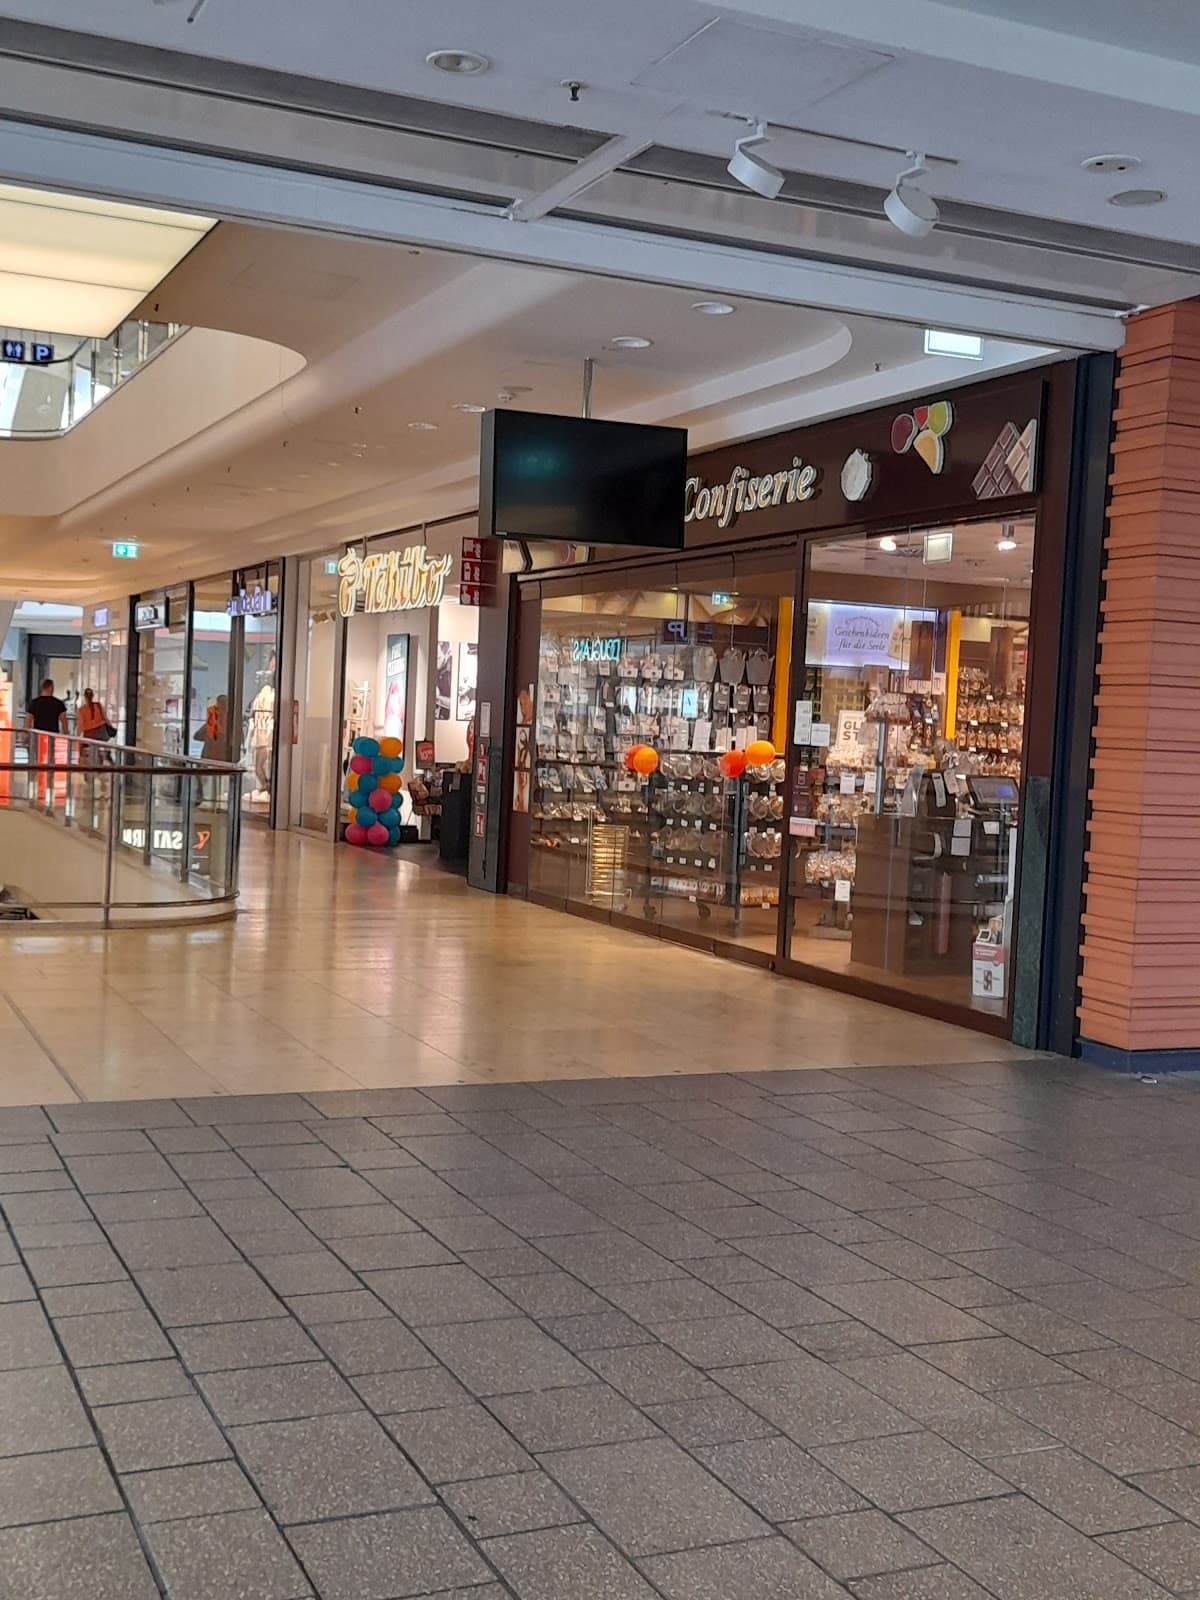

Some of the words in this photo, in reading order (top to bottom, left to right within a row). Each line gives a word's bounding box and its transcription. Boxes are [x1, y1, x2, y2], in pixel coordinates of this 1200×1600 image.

[36, 344, 50, 360] P
[684, 456, 817, 528] Confiserie
[361, 546, 453, 613] Tchibo
[834, 625, 890, 639] Geschenkideen
